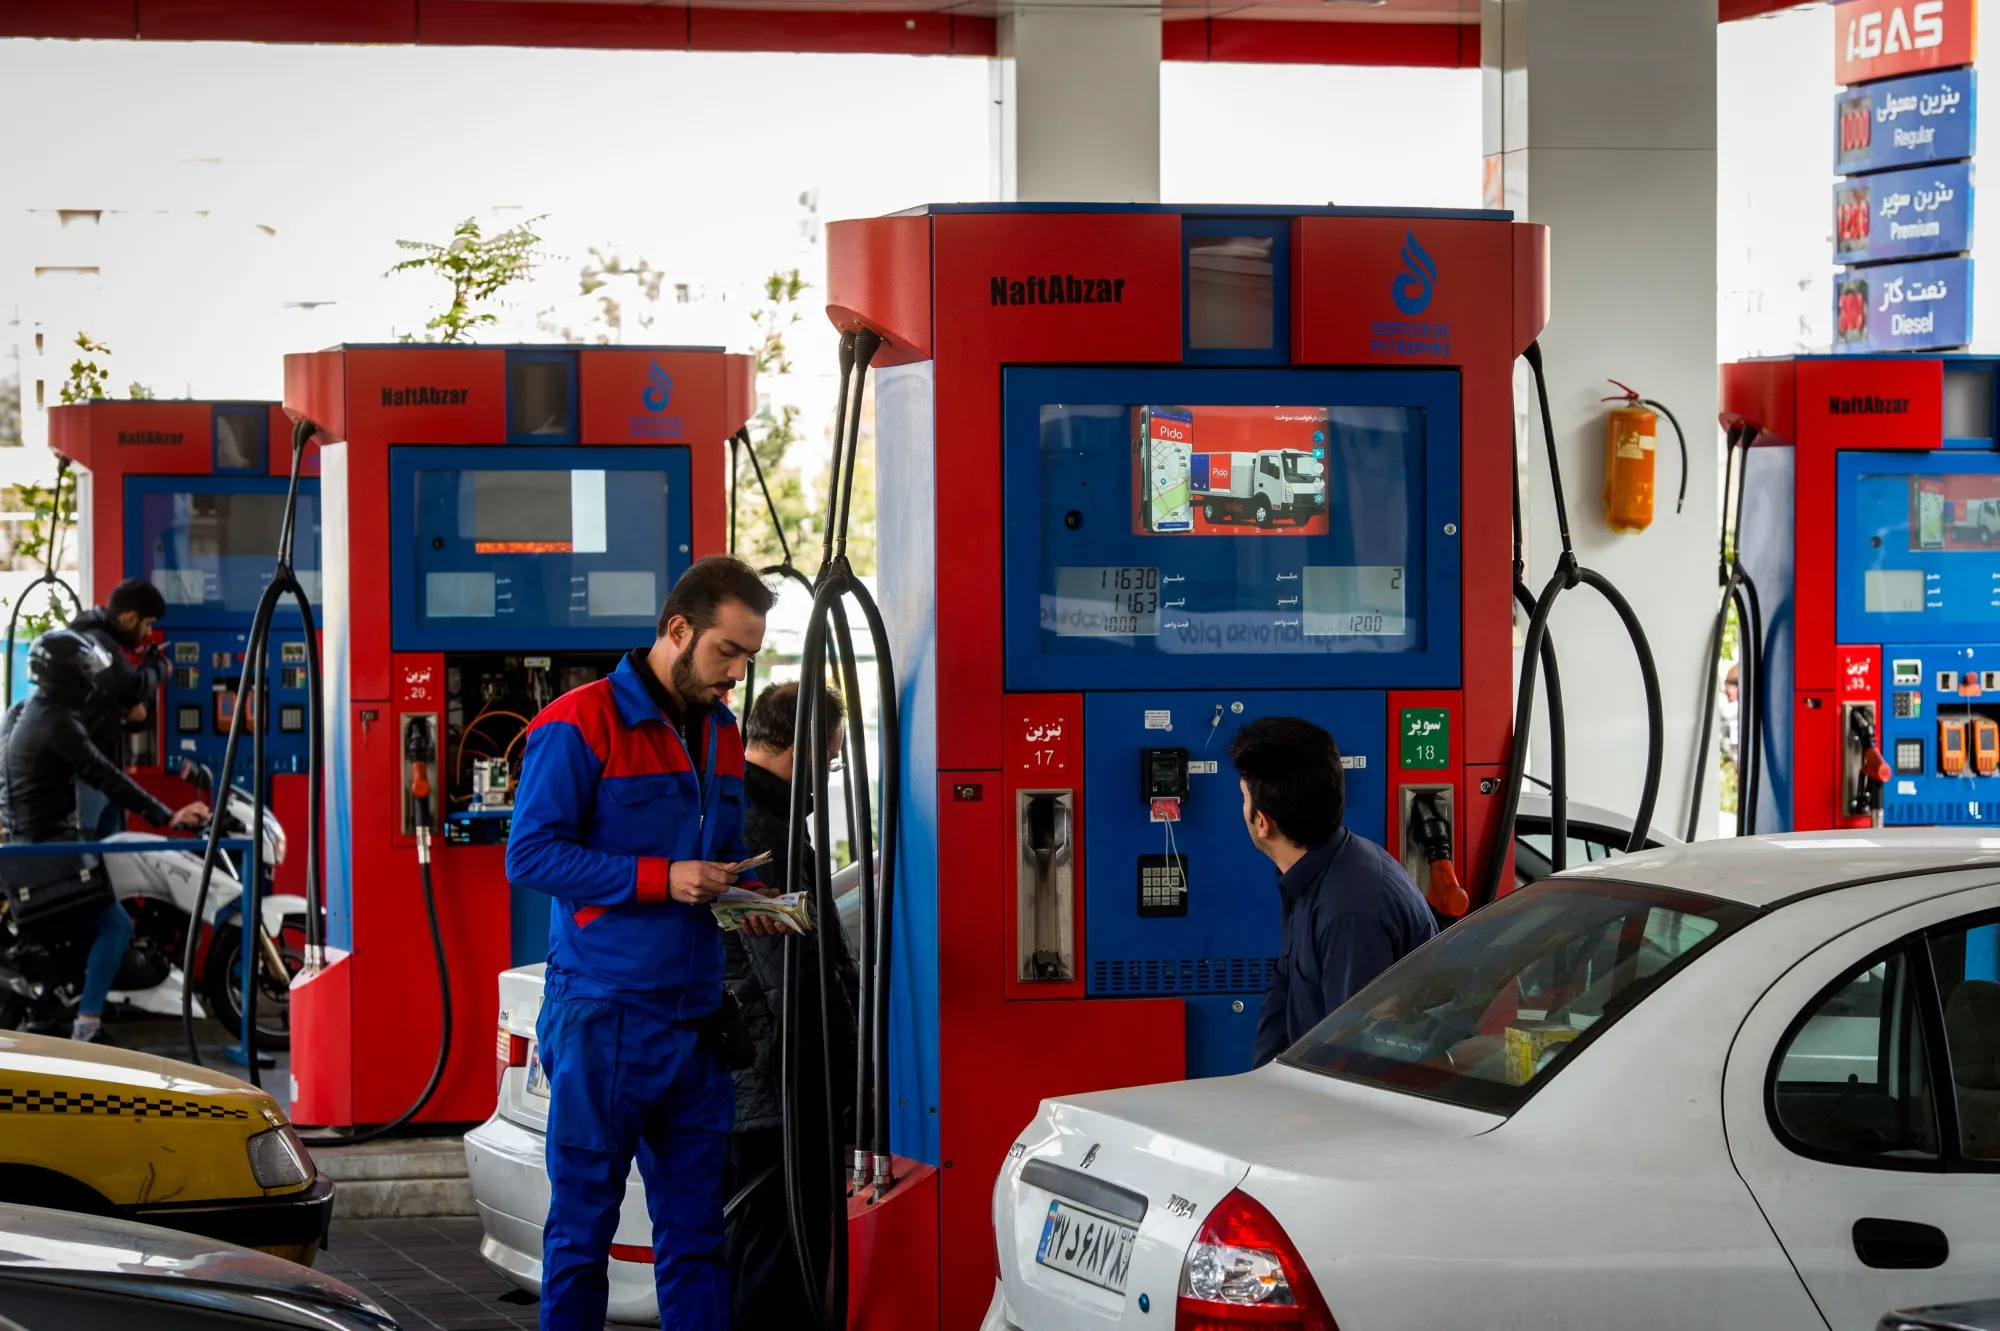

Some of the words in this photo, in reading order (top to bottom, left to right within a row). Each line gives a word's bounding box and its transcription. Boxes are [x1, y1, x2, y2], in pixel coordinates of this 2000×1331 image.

[1893, 125, 1935, 150] Regular
[1889, 219, 1940, 241] Premium
[991, 274, 1125, 306] NaftAbzar
[1891, 312, 1934, 336] Diesel
[382, 386, 468, 406] NaftAbzar
[1829, 396, 1909, 415] NaftAbzar
[1160, 425, 1183, 440] Pido
[1102, 568, 1157, 590] 11630
[1163, 574, 1185, 583] مبلغ
[1276, 572, 1298, 581] مبلغ
[1391, 568, 1402, 590] 2
[1164, 597, 1185, 608] لیتر
[1276, 596, 1298, 606] لیتر
[1104, 616, 1138, 632] 1000
[1350, 615, 1382, 632] 1200
[1026, 722, 1062, 742] بنزین
[1407, 719, 1441, 736] سوپر
[1034, 749, 1054, 765] 17
[1416, 745, 1435, 760] 18
[1165, 1193, 1197, 1219] TIBA
